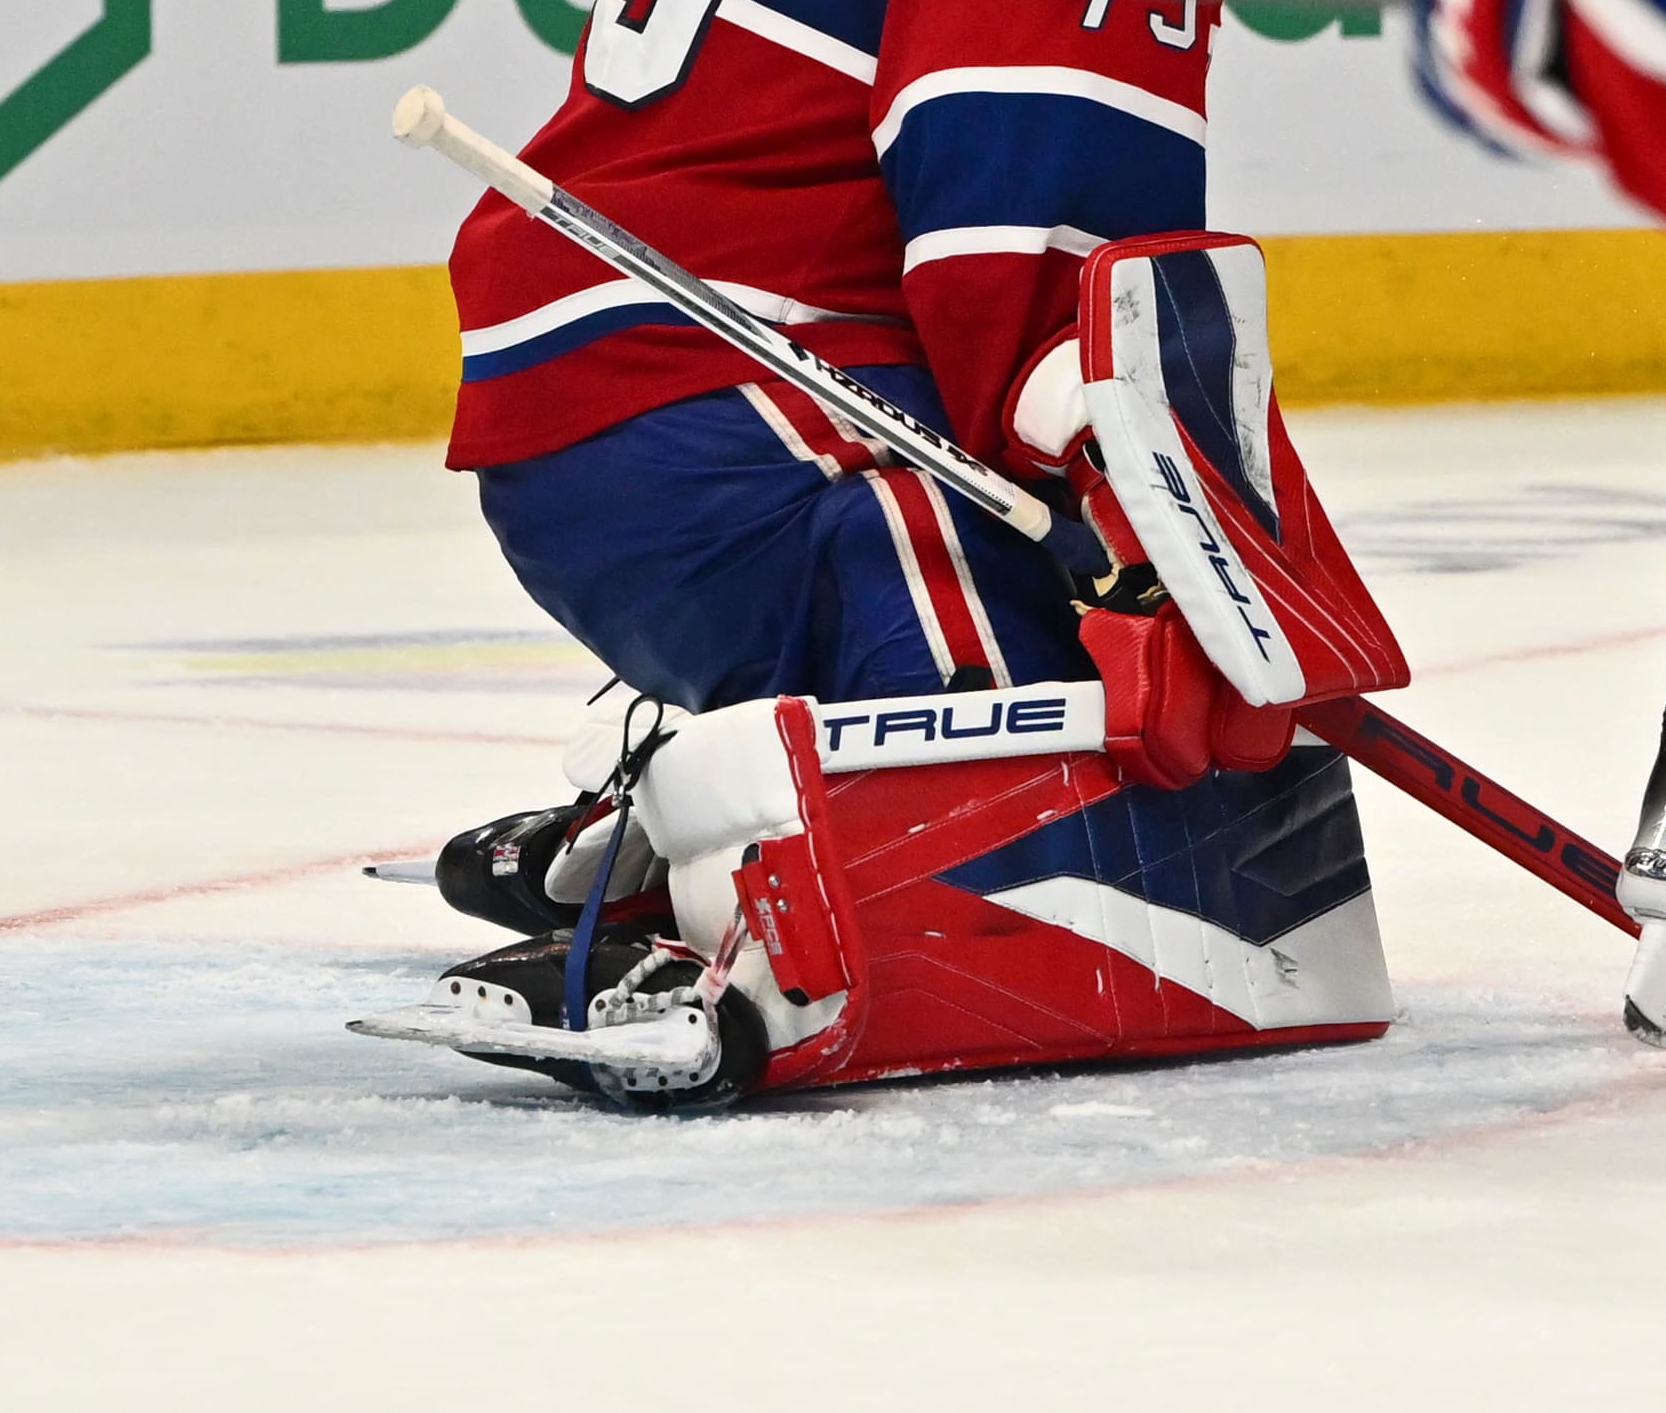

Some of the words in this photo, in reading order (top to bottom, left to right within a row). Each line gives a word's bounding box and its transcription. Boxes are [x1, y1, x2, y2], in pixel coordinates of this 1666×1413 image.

[1151, 451, 1272, 664] TRUE
[824, 698, 1066, 752] TRUE
[1355, 710, 1621, 900] RUE
